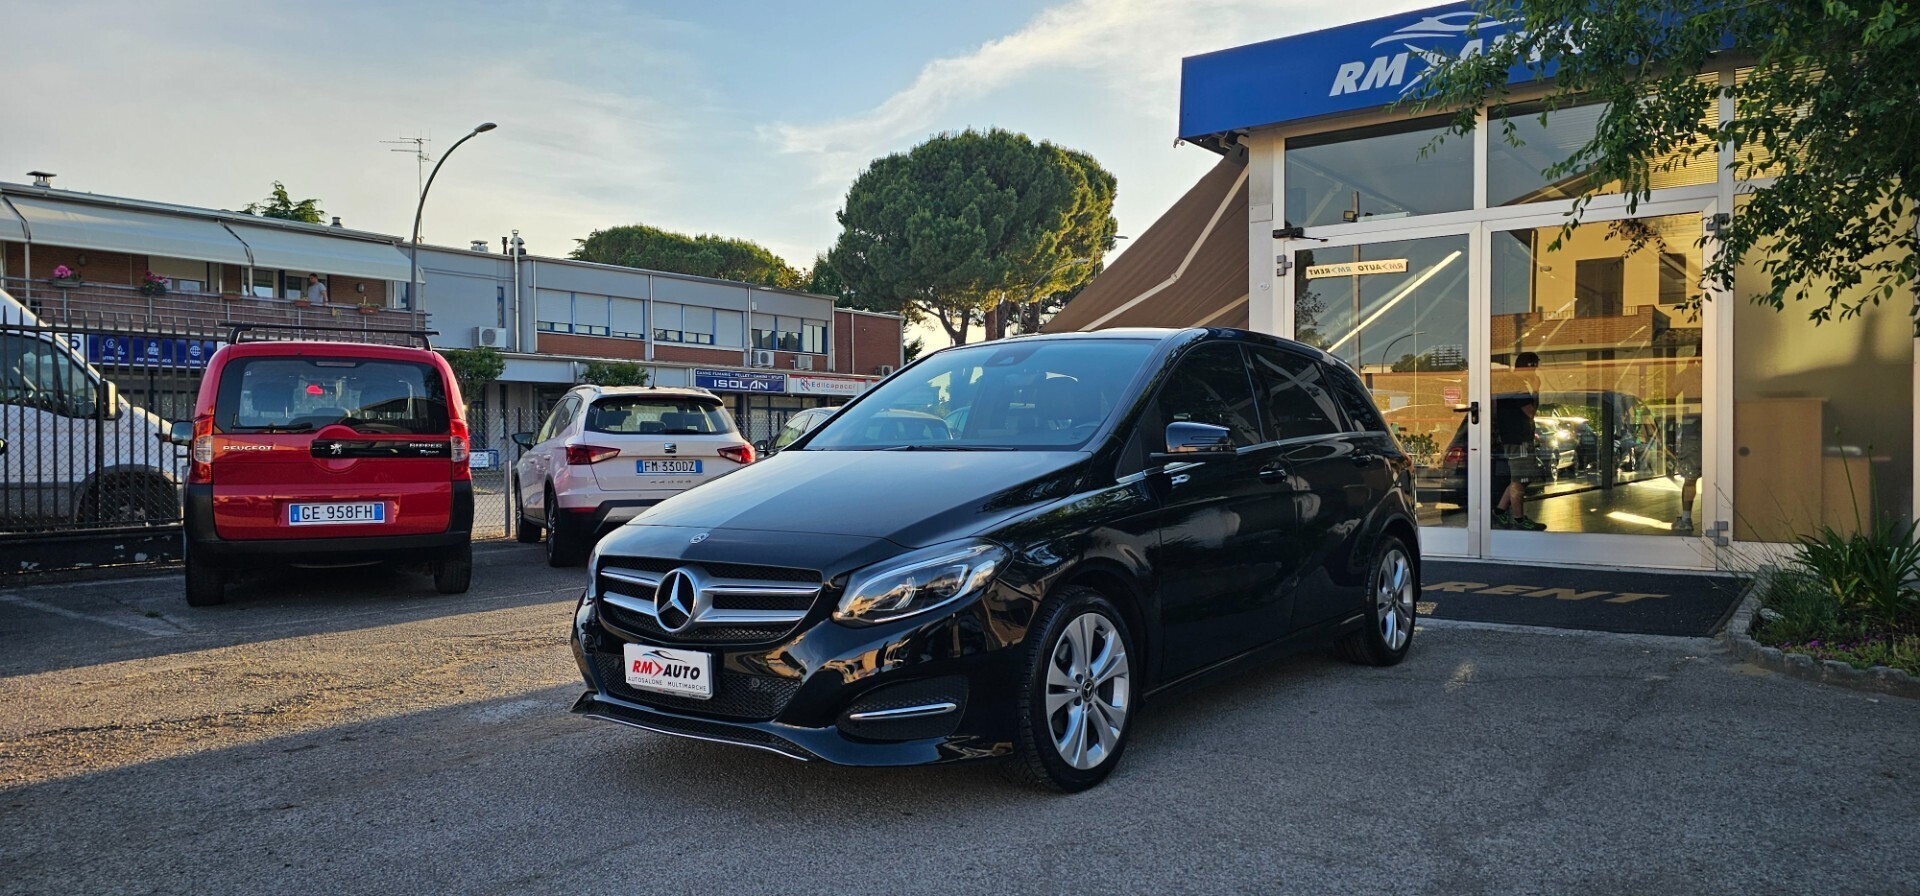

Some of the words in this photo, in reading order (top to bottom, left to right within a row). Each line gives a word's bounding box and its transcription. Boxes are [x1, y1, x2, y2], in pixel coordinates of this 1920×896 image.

[713, 379, 769, 391] ISOLAN
[644, 461, 659, 472] FM
[662, 461, 695, 472] 330DZ
[301, 506, 321, 520] GE
[326, 505, 373, 520] 958FH
[1421, 581, 1671, 604] RENT
[662, 663, 701, 681] AUTO
[627, 676, 663, 686] AUTOSALONE
[667, 681, 707, 692] MULTIMARCHE
